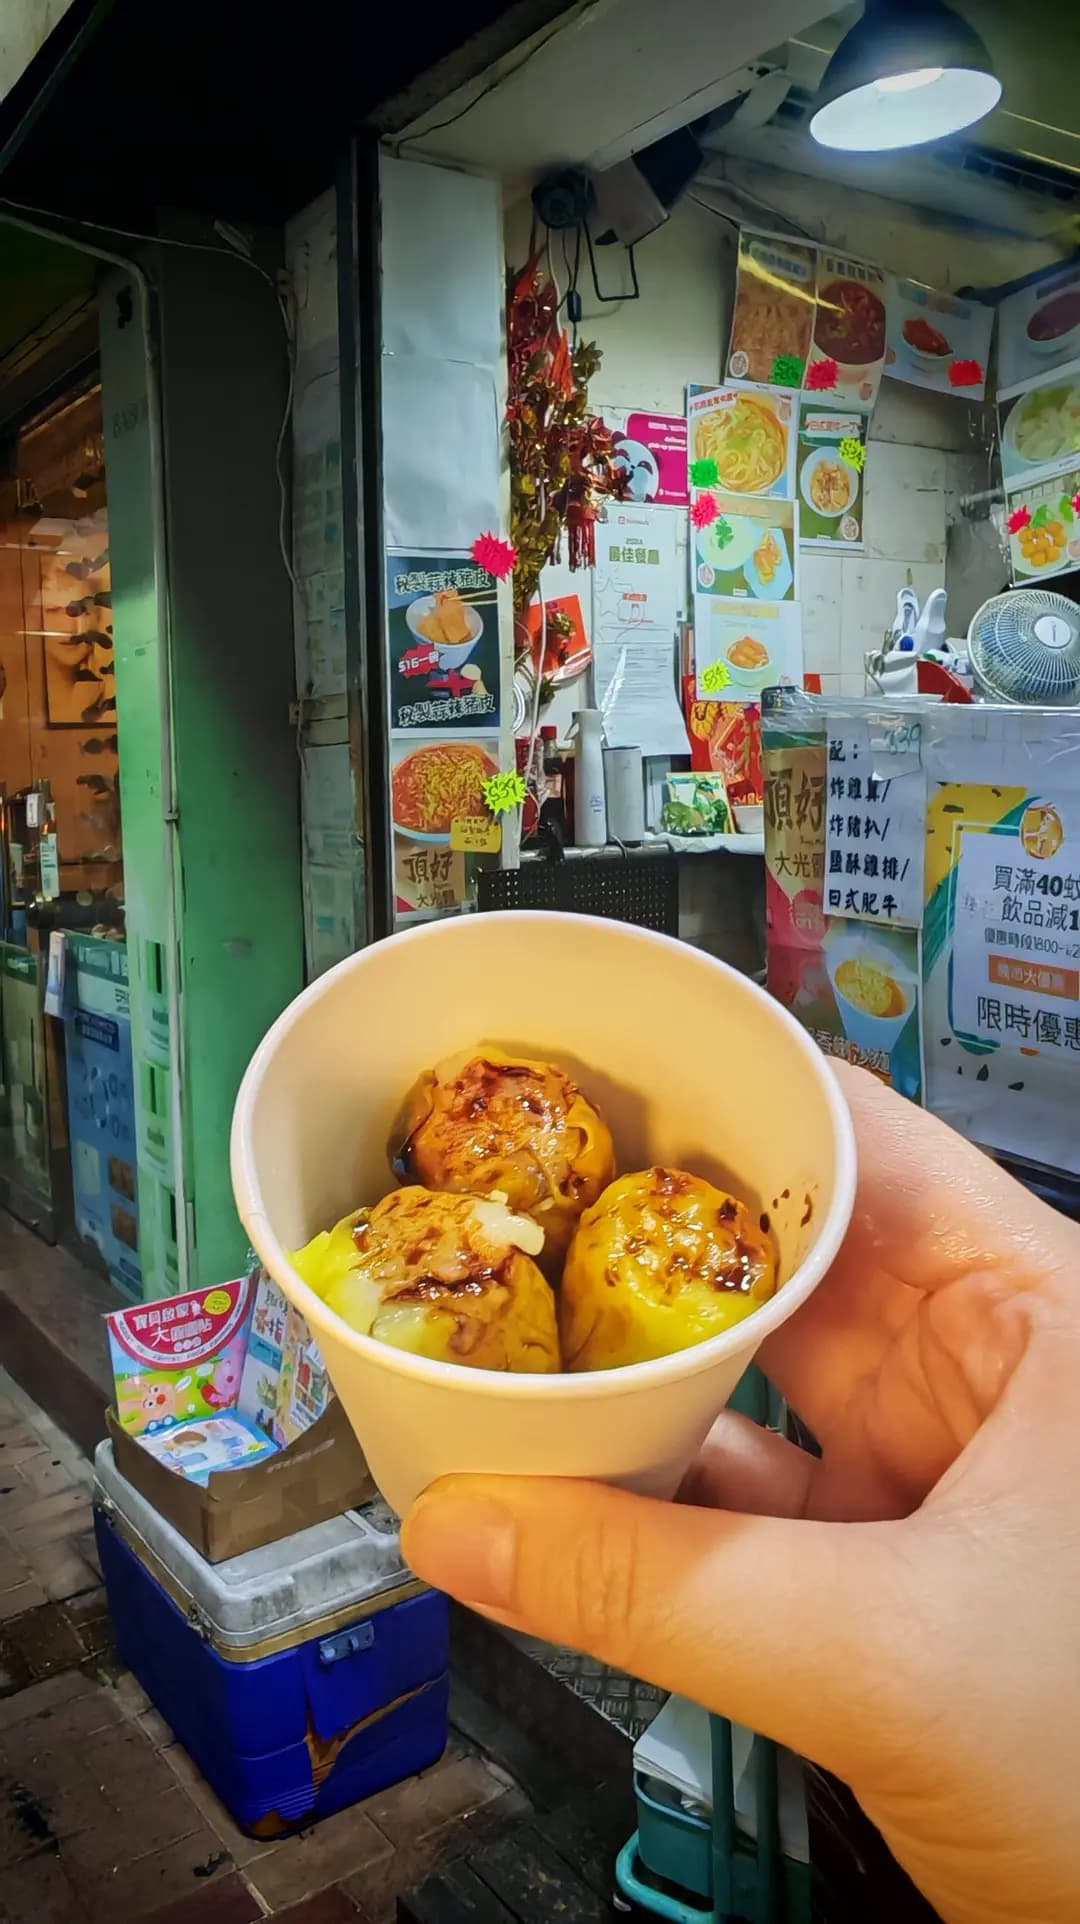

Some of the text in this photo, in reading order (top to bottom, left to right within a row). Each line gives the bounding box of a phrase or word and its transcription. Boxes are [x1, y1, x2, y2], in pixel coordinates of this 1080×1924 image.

[829, 814, 890, 841] 炸豬扒/
[402, 850, 453, 884] 頂好
[992, 865, 1080, 902] 買滿40蚊
[829, 889, 898, 918] 日式肥牛
[976, 996, 1080, 1051] 限時優惠
